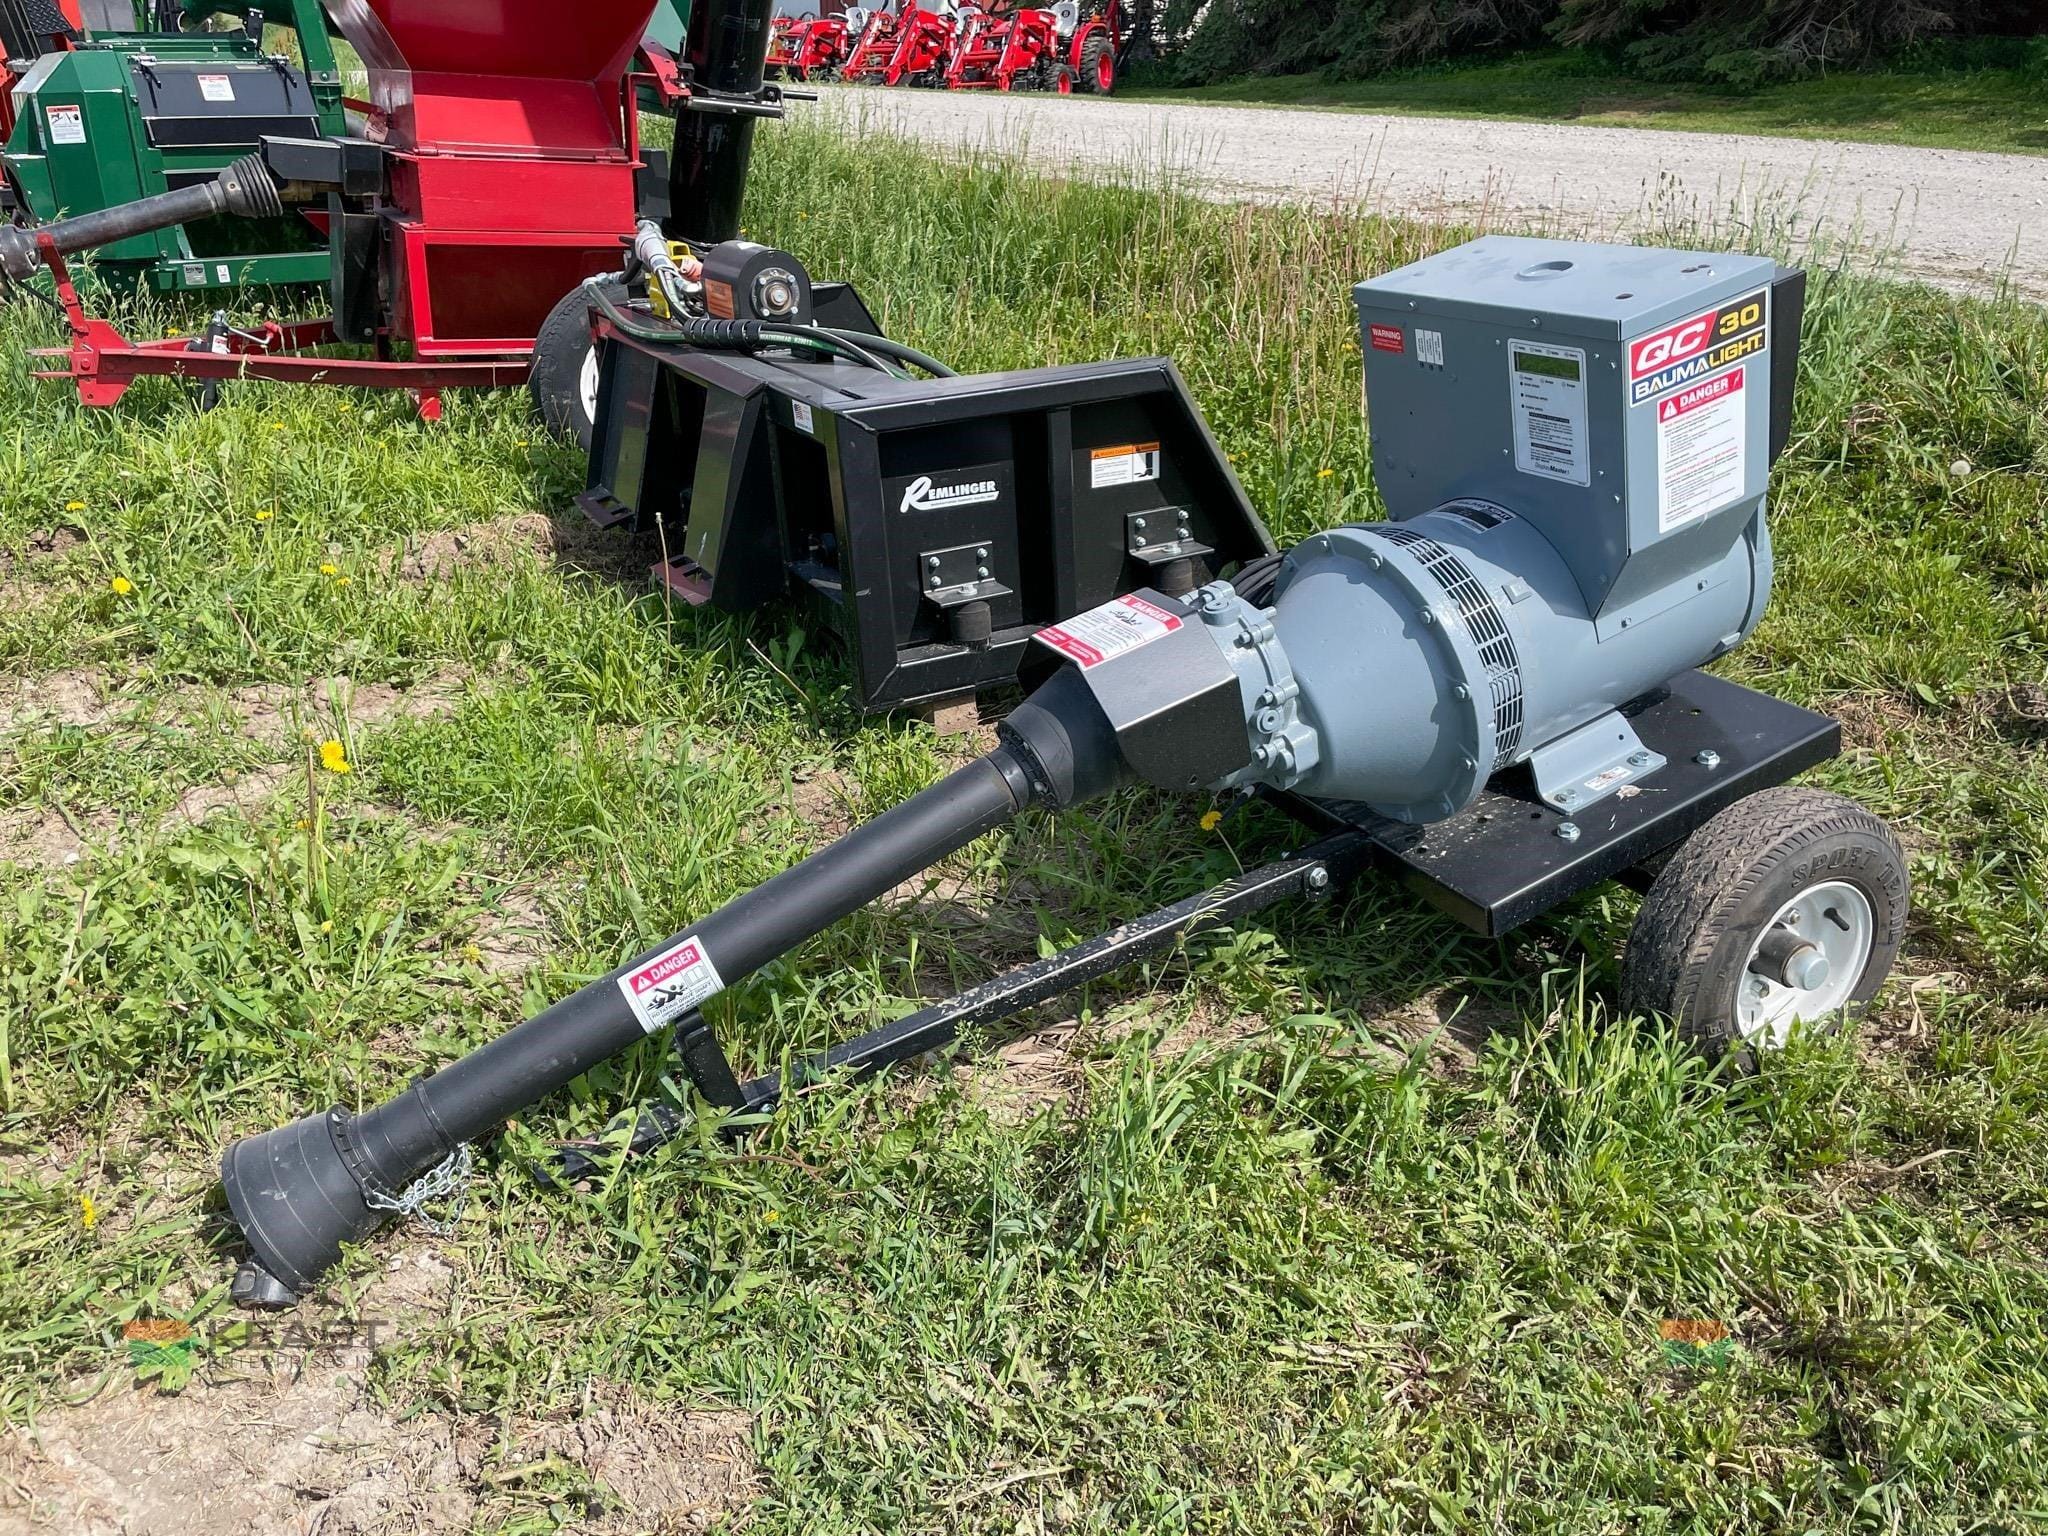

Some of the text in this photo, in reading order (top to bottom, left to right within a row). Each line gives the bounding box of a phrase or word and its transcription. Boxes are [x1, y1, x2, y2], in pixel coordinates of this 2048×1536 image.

[1372, 328, 1401, 340] WARNING
[1636, 303, 1760, 372] QC 30
[1635, 332, 1763, 400] BAUMALIGHT
[1680, 377, 1729, 407] DANGER
[900, 476, 996, 513] REMLINGER
[1132, 602, 1172, 622] DANGER
[1792, 846, 1880, 888] SPORT
[650, 949, 695, 981] DANGER
